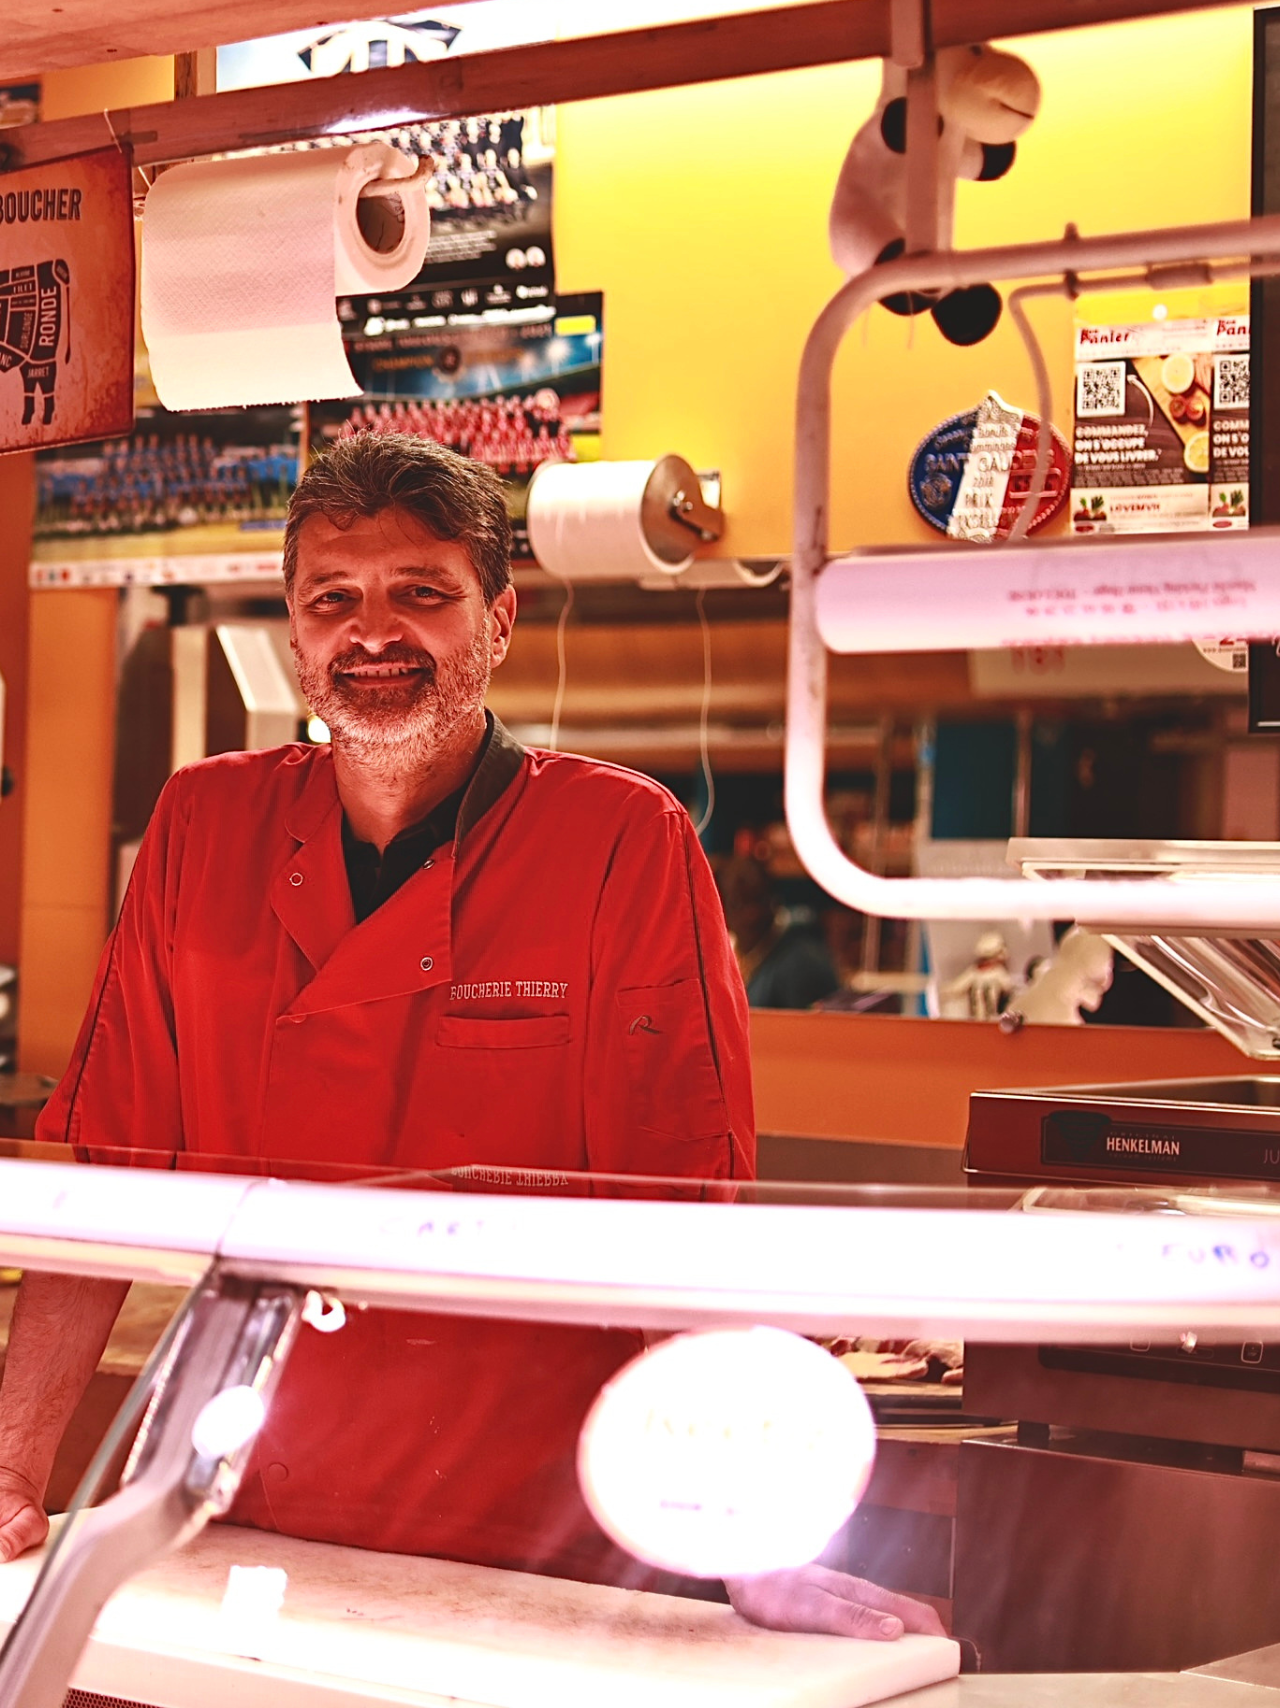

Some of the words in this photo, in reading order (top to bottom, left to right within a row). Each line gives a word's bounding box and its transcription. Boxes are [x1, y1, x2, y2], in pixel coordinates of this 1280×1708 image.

[38, 286, 57, 346] RONDE
[27, 366, 49, 378] JARRET
[978, 450, 1055, 473] GAUDES
[450, 981, 511, 1000] BOUCHERIE
[515, 981, 569, 999] THIERRY
[1106, 1136, 1181, 1156] HENKELMAN
